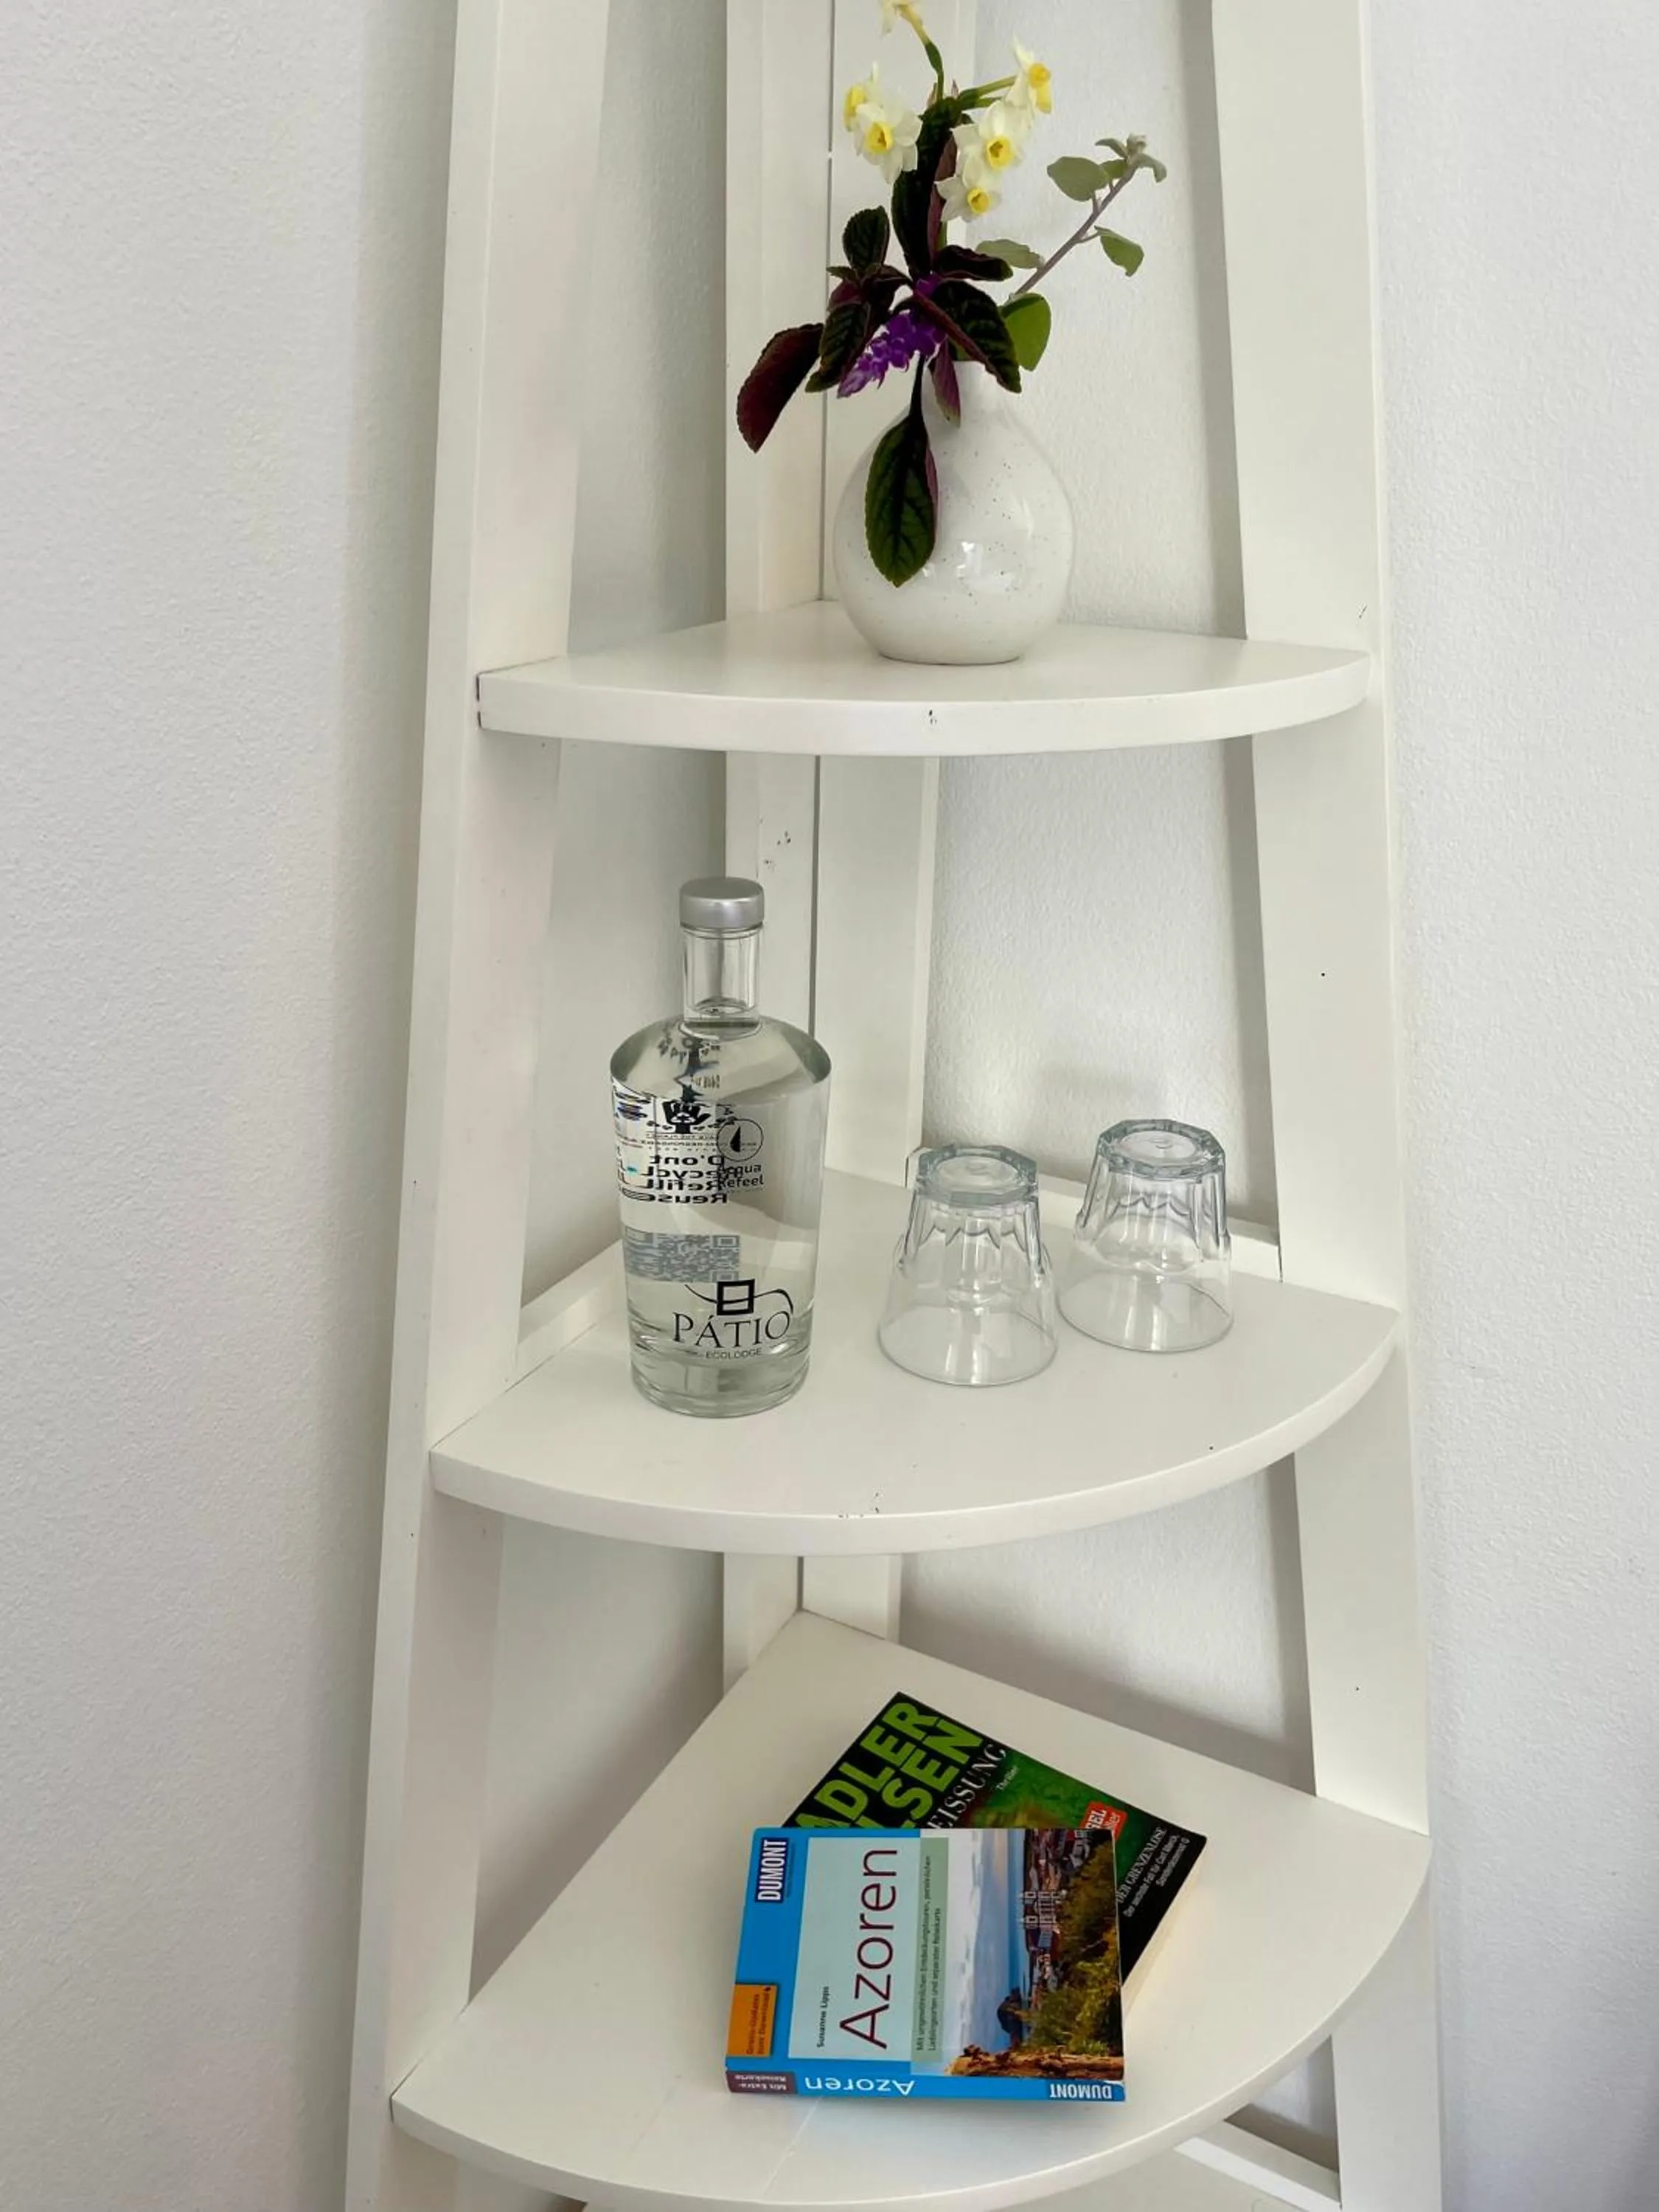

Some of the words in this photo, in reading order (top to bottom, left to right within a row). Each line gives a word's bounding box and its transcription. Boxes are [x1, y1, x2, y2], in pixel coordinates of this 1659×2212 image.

[672, 1311, 791, 1349] PÁTIO
[757, 1838, 787, 1902] DUMONT
[838, 1848, 898, 2051] Azoren
[819, 1986, 830, 2009] Lipps
[816, 2010, 827, 2048] Susanne
[804, 2075, 915, 2096] Azoren
[1048, 2080, 1113, 2098] DUMONT
